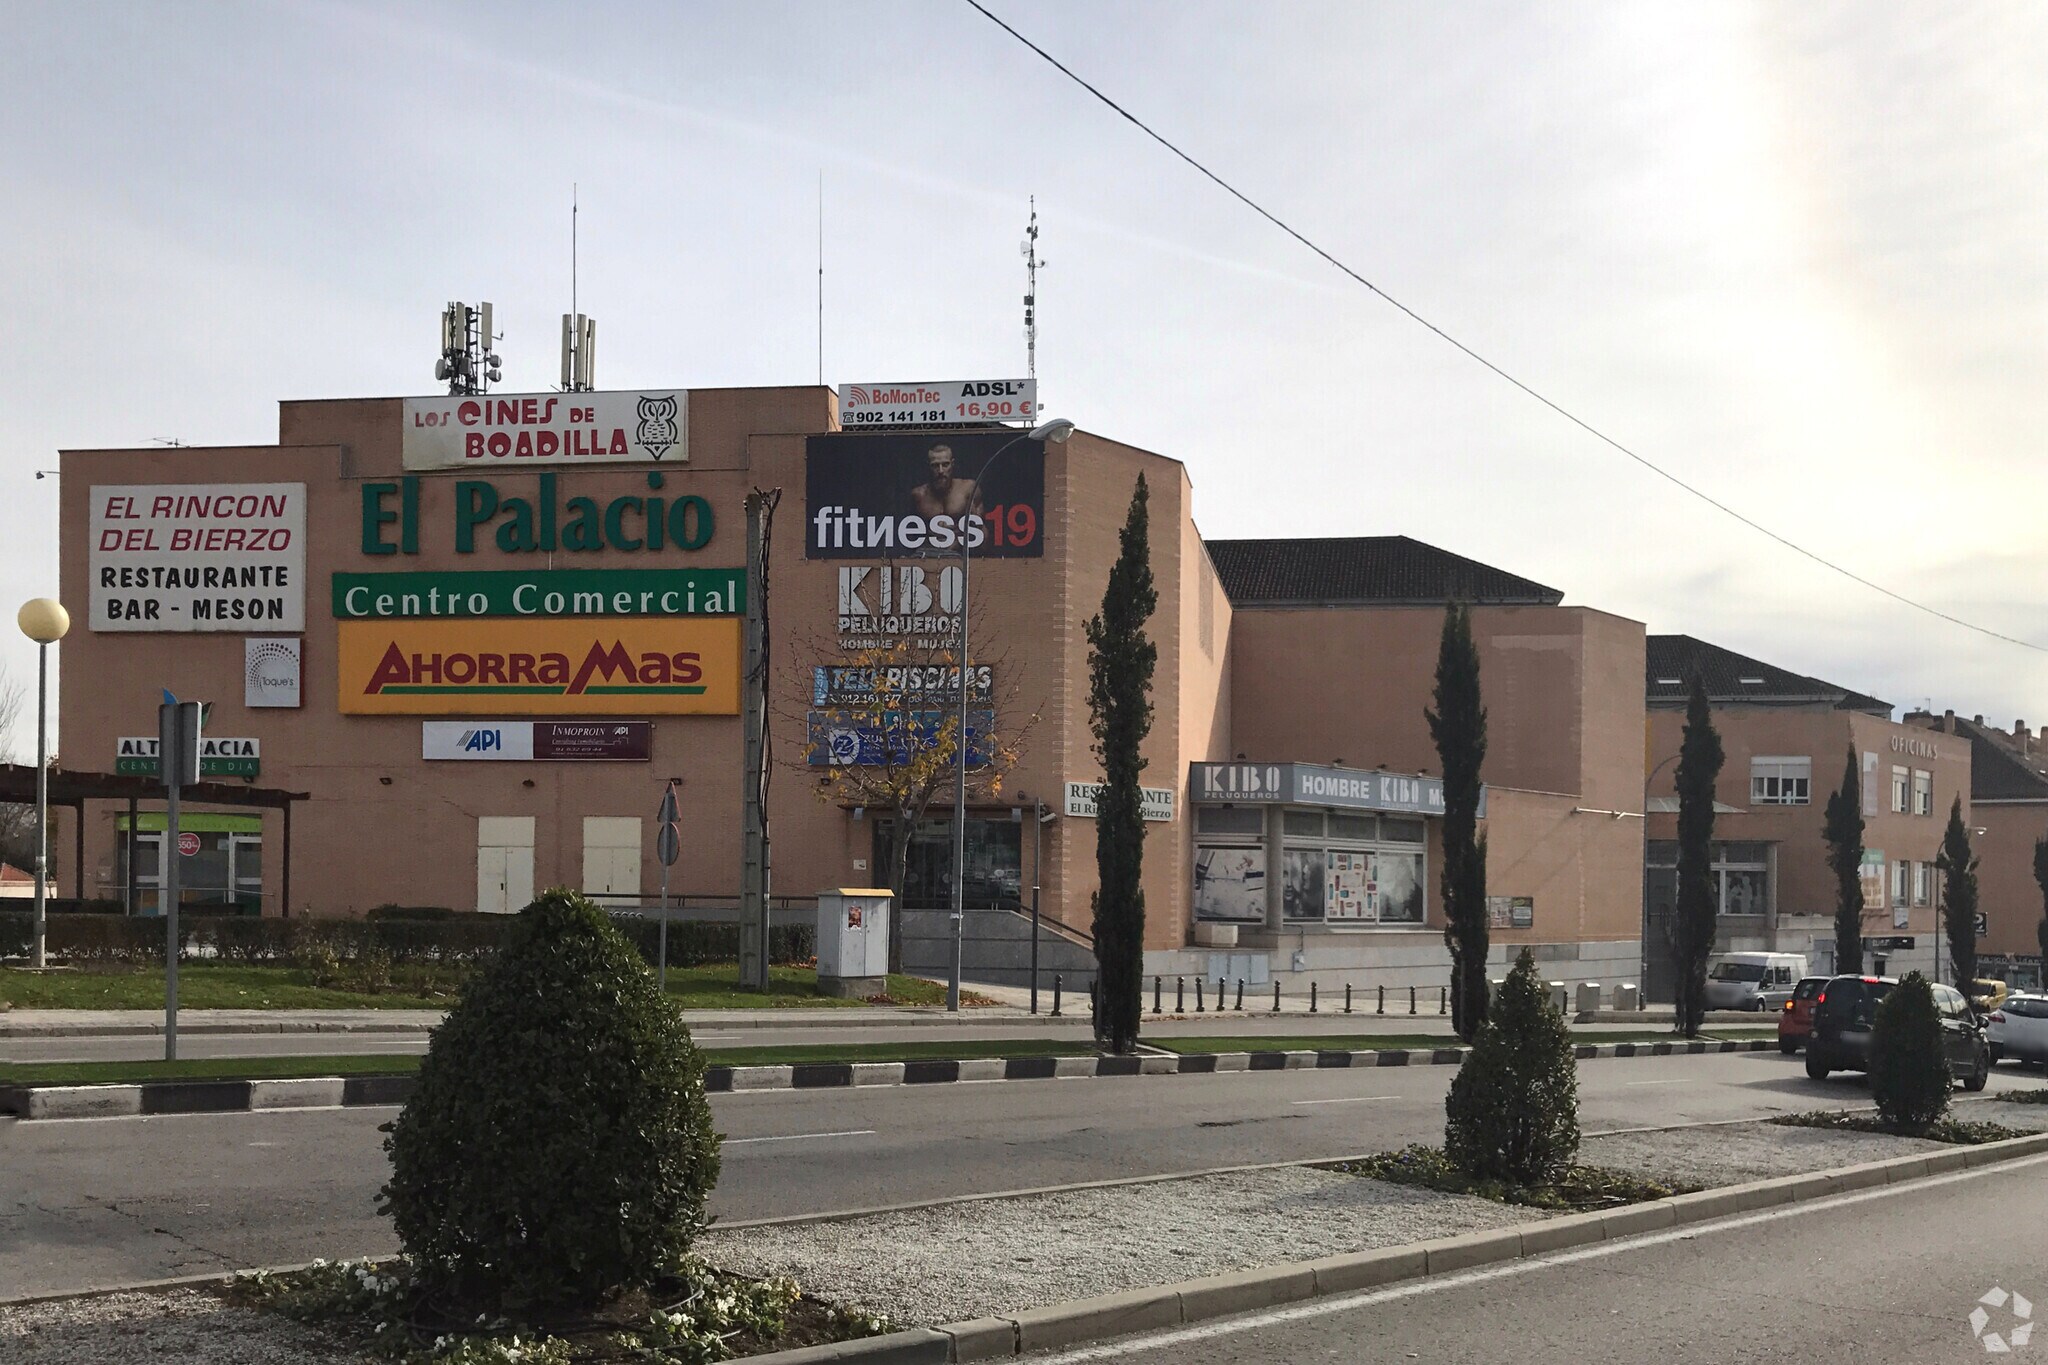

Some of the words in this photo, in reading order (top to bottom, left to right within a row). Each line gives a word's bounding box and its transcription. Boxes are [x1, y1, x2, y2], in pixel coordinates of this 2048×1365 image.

[872, 388, 941, 404] BoMonTec
[457, 398, 558, 426] CINES
[570, 408, 595, 423] DE
[856, 411, 883, 422] 902
[889, 411, 914, 422] 141
[920, 410, 946, 421] 181
[956, 401, 1012, 419] 16,90
[1019, 401, 1032, 415] €
[465, 429, 628, 458] BOADILLA
[105, 496, 141, 519] EL
[150, 495, 287, 518] RINCON
[361, 476, 420, 554] El
[455, 471, 714, 553] Palacio
[99, 529, 160, 551] DEL
[170, 529, 291, 551] BIERZO
[101, 566, 288, 588] RESTAURANTE
[345, 586, 488, 616] Centro
[512, 581, 736, 613] Comercial
[838, 566, 963, 615] KIBO
[107, 598, 160, 620] BAR
[192, 599, 283, 619] MESON
[838, 616, 962, 634] PELUQUEROS
[121, 740, 255, 756] ALTACIA
[465, 729, 501, 752] API
[1891, 735, 1938, 759] OFICINAS
[227, 762, 253, 771] DIA
[1204, 766, 1280, 792] KIBO
[1302, 775, 1369, 799] HOMBRE
[1380, 777, 1419, 803] KIBO
[1070, 803, 1081, 813] El
[1140, 807, 1171, 818] Bierzo
